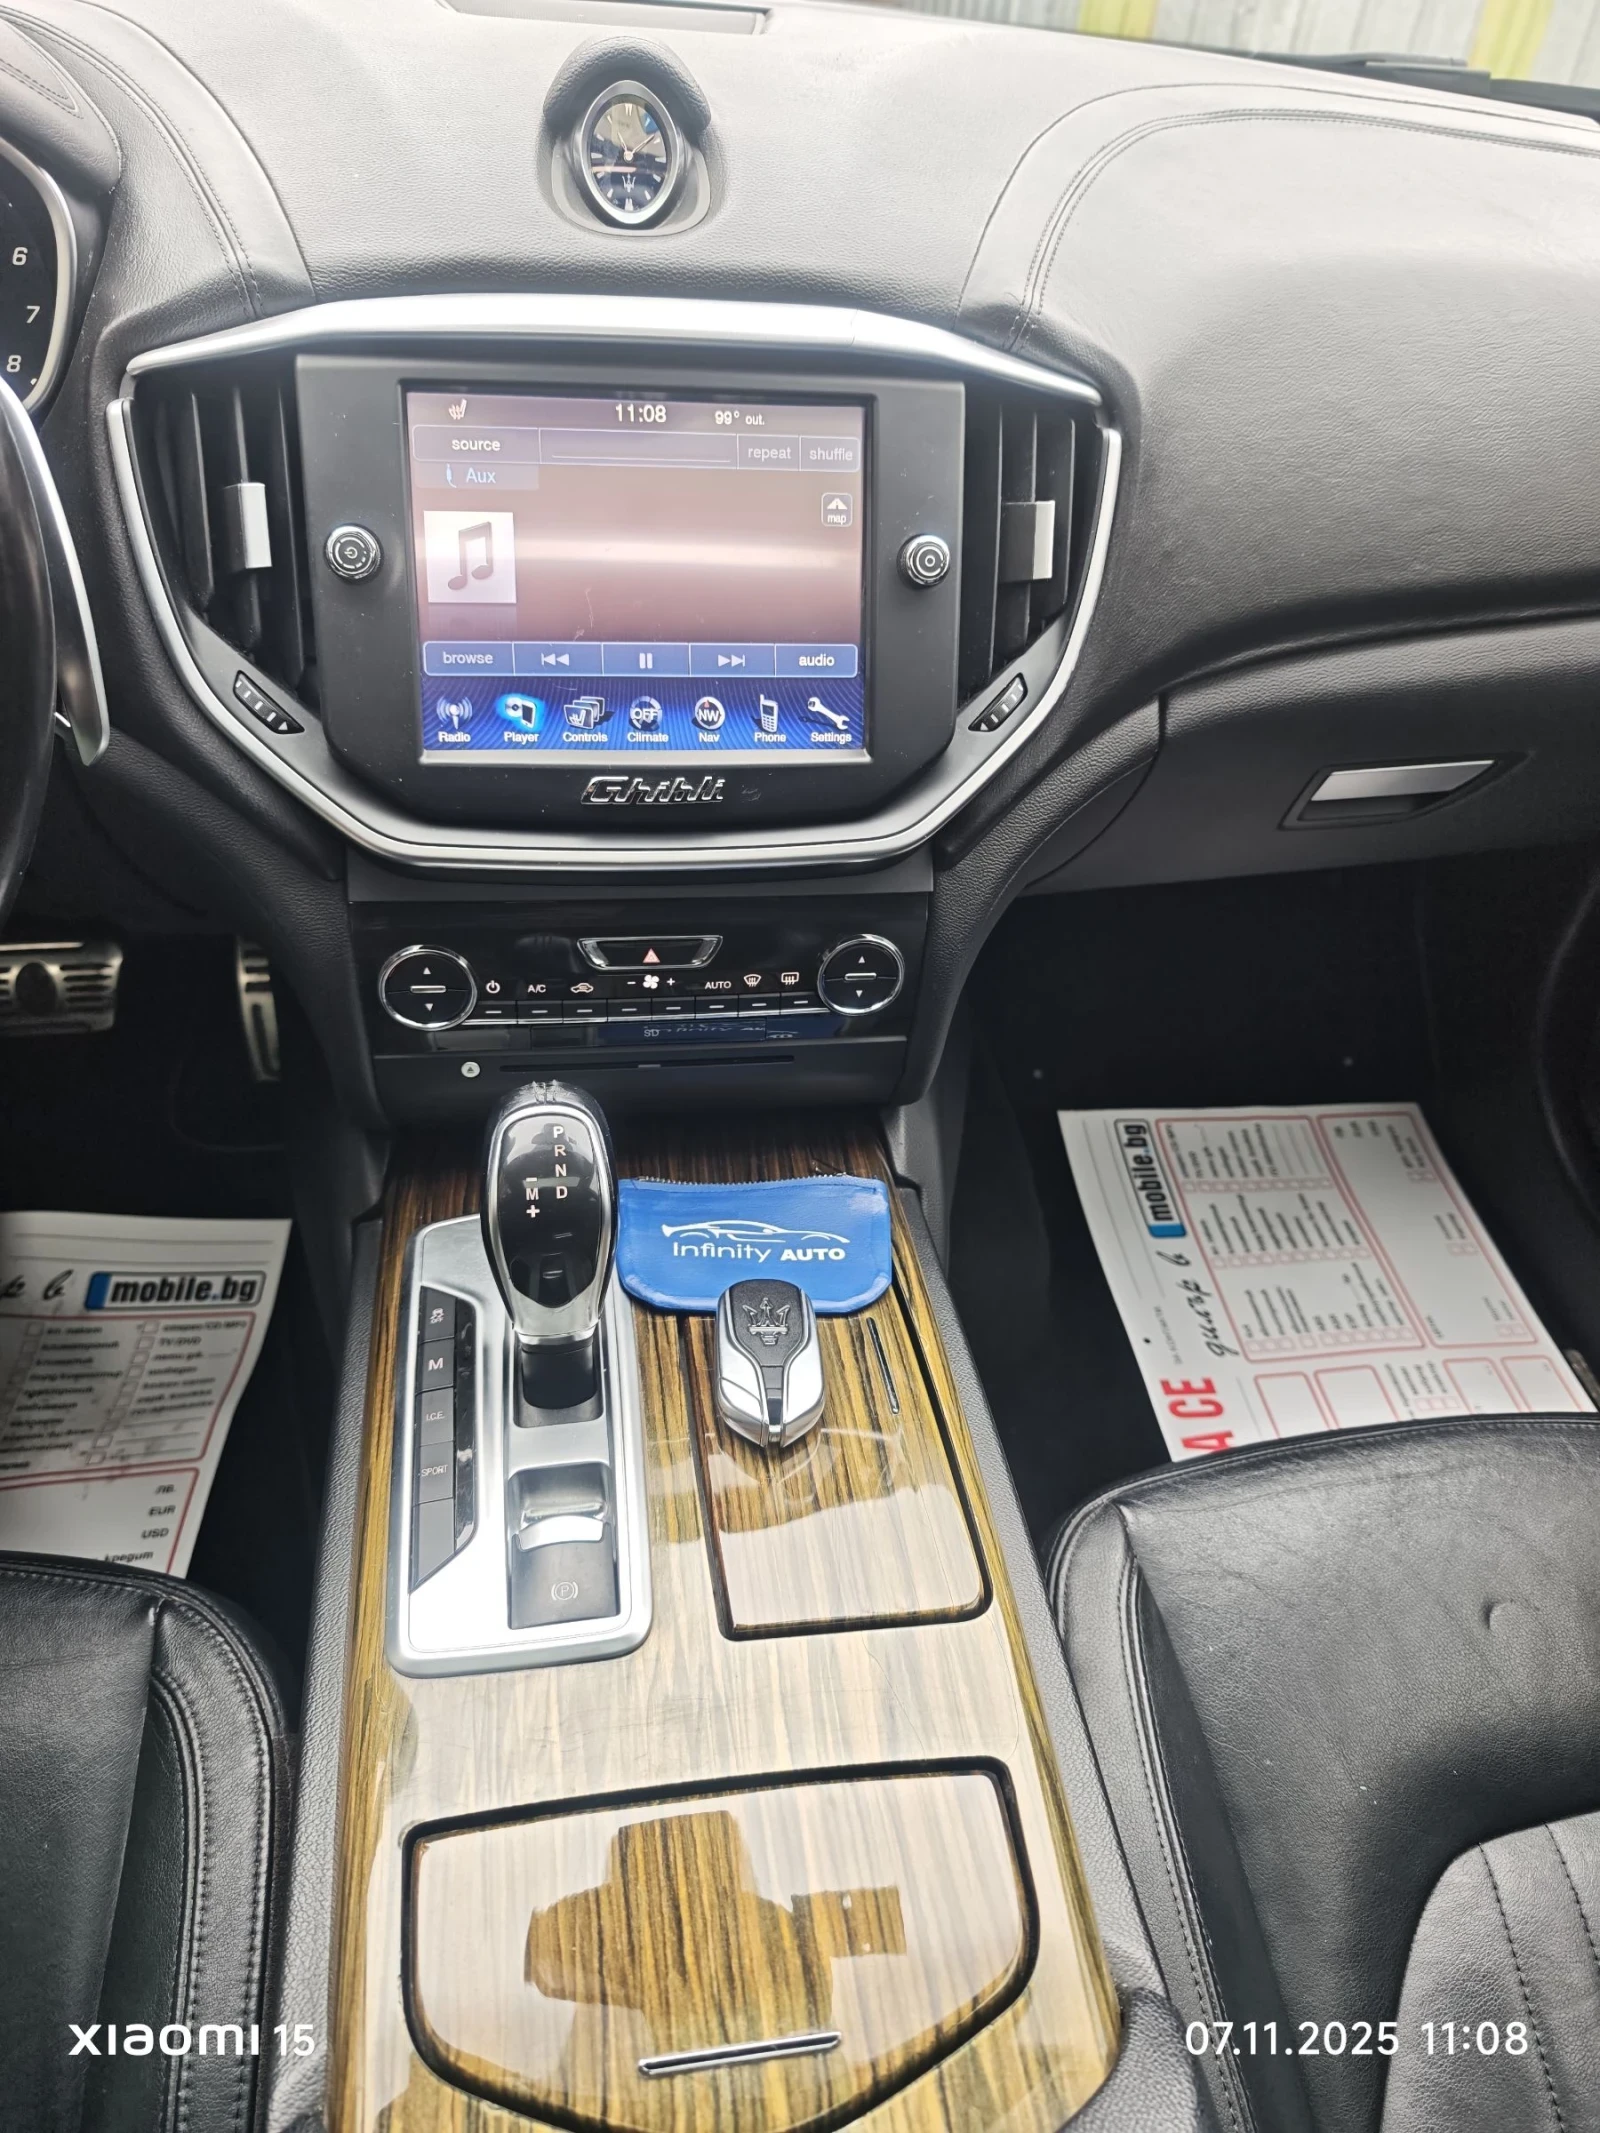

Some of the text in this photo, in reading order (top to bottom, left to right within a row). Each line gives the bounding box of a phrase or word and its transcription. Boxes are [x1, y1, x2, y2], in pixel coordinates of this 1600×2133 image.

[12, 247, 28, 266] 6
[26, 305, 41, 324] 7
[6, 355, 22, 372] 8
[615, 403, 667, 423] 11:08
[715, 411, 766, 426] 99° out.
[452, 438, 501, 452] source
[748, 445, 792, 462] repeat
[809, 446, 853, 462] shuffle
[466, 468, 496, 484] Aux
[827, 515, 846, 526] map
[443, 651, 493, 665] browse
[798, 653, 835, 667] audio
[630, 708, 658, 720] OFF
[698, 708, 719, 721] NW
[438, 731, 471, 743] Radio
[503, 731, 539, 745] Player
[562, 731, 608, 744] Controls
[627, 731, 669, 744] Climate
[698, 732, 720, 744] Nav
[754, 731, 786, 744] Phone
[810, 731, 852, 745] Settings
[580, 776, 725, 805] Ghibli
[528, 983, 546, 994] A/C
[704, 980, 732, 990] AUTO
[553, 1126, 564, 1138] P
[554, 1144, 566, 1157] R
[555, 1164, 567, 1177] N
[1123, 1123, 1174, 1221] mobile.bg
[526, 1187, 539, 1201] M
[556, 1186, 568, 1199] D
[673, 1242, 846, 1263] Infinity AUTO
[111, 1276, 258, 1304] mobile.bg
[428, 1357, 444, 1371] M
[421, 1465, 449, 1477] SPORT
[148, 1505, 176, 1516] EUR
[141, 1528, 169, 1539] USD
